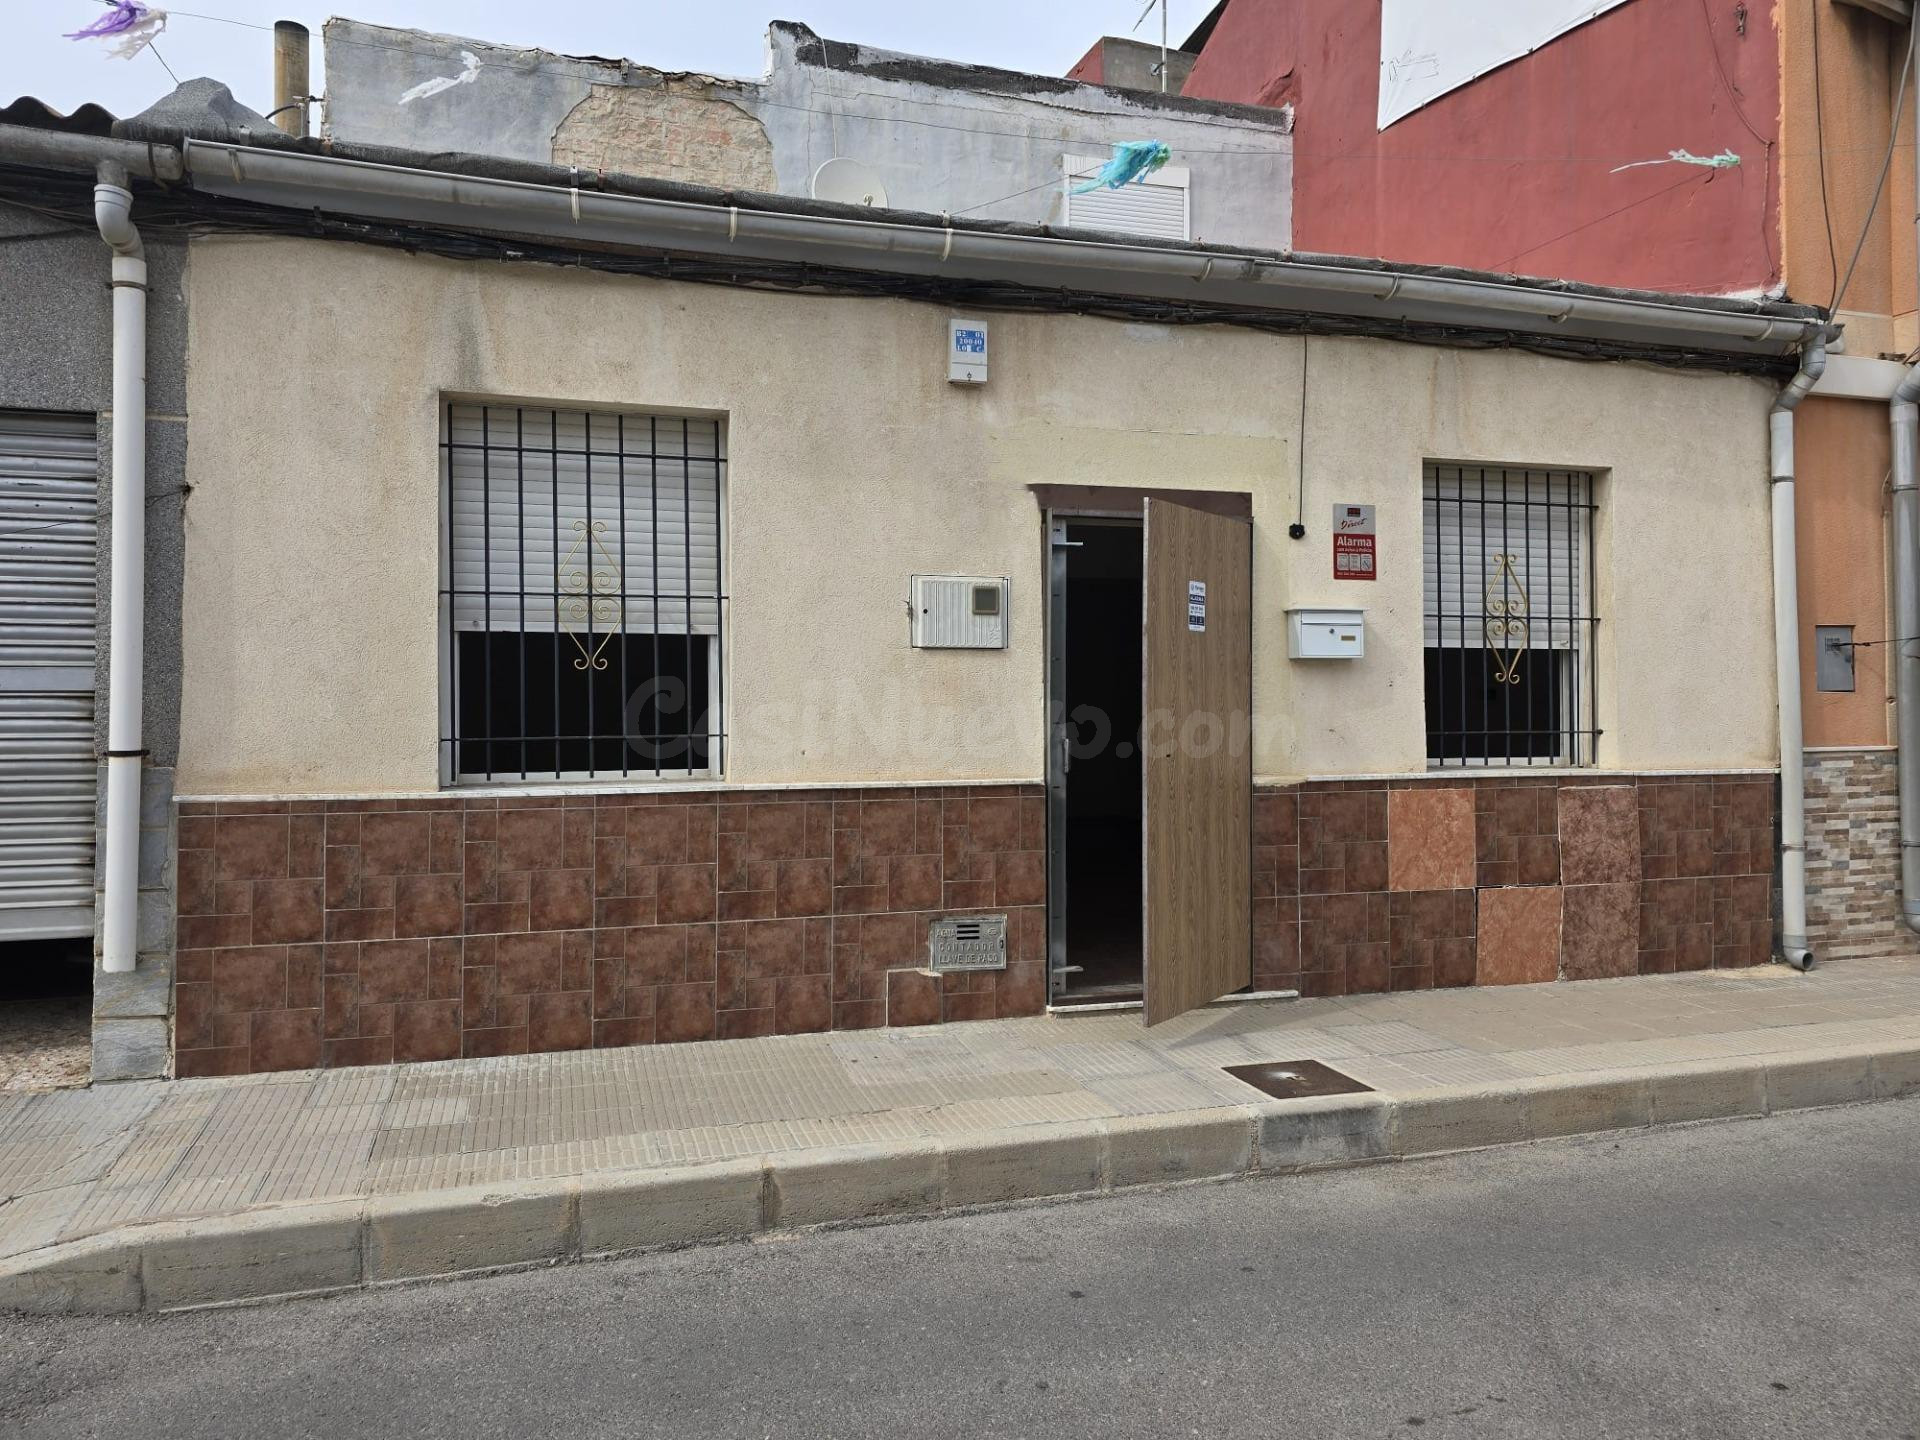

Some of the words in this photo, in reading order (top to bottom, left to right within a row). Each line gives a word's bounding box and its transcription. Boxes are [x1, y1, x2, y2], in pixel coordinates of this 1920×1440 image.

[1337, 536, 1372, 547] Alarma
[938, 941, 995, 952] CONTADOR
[939, 954, 963, 964] LLAVE
[965, 954, 976, 964] DE
[976, 953, 998, 963] PASO
